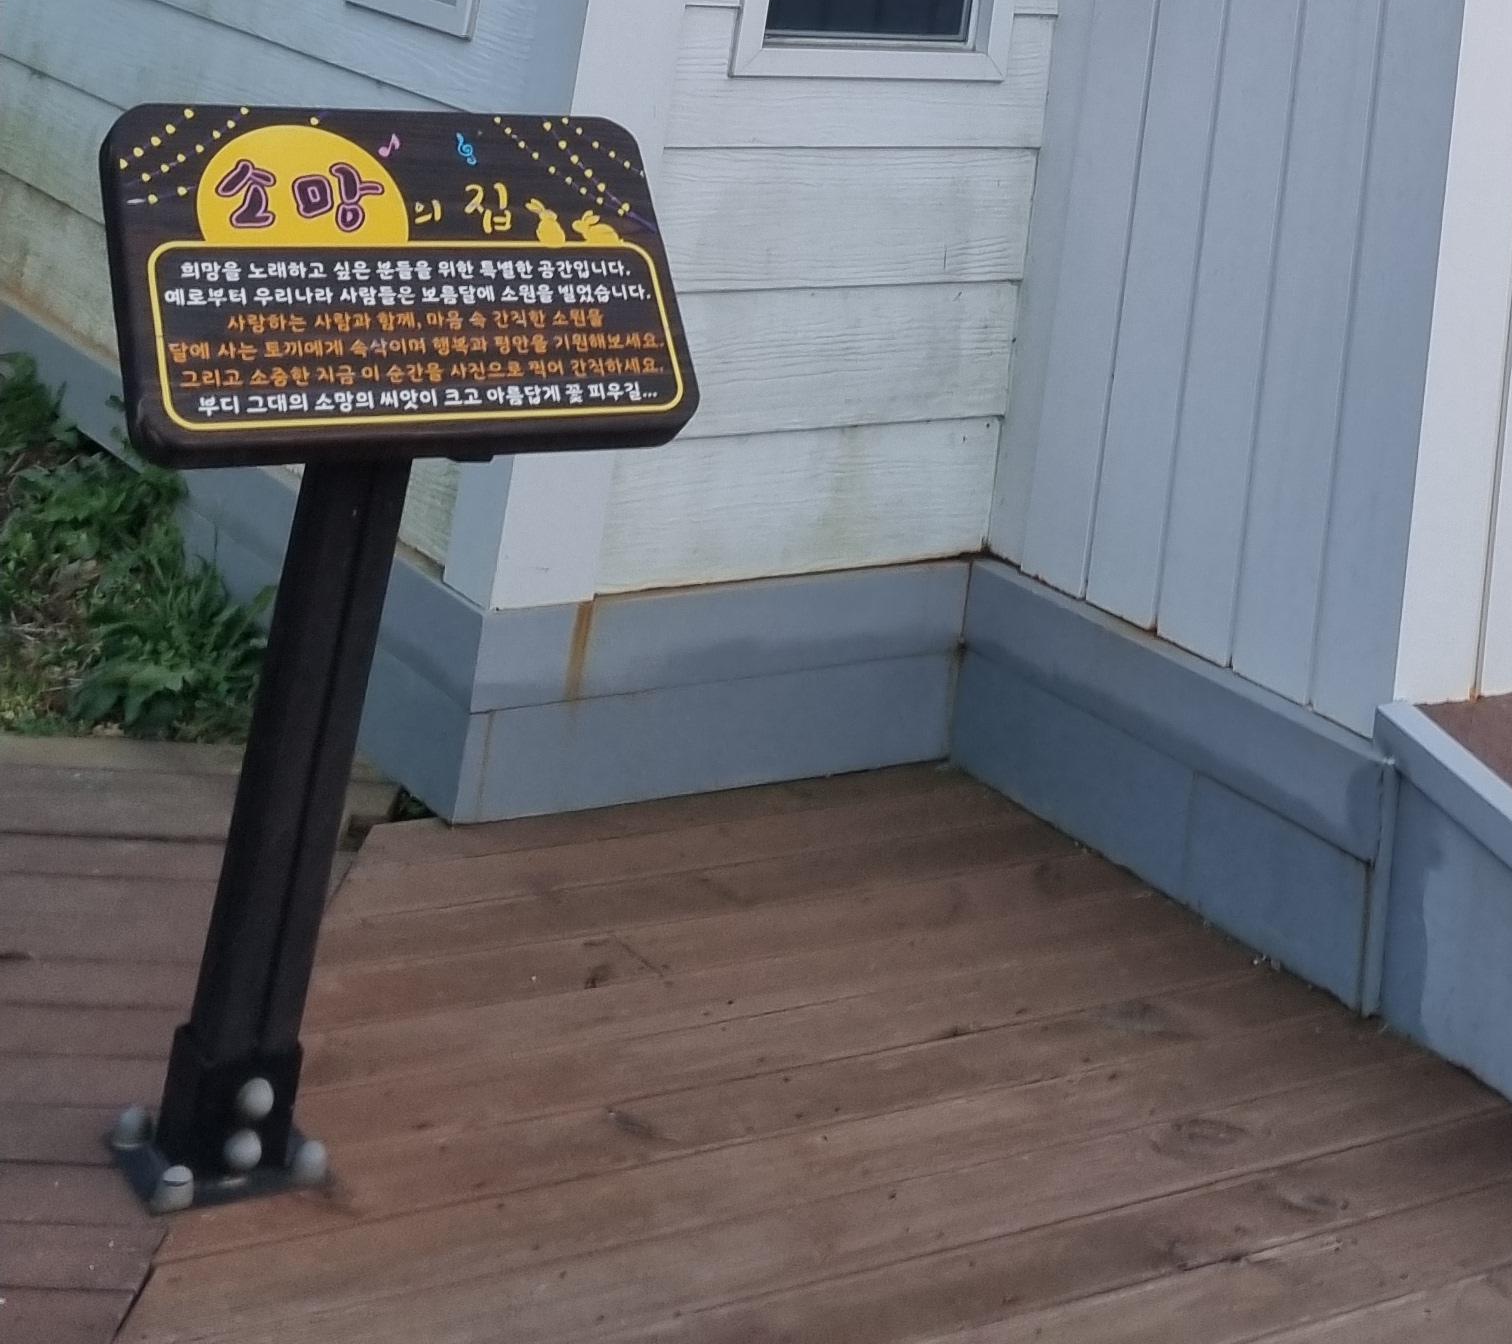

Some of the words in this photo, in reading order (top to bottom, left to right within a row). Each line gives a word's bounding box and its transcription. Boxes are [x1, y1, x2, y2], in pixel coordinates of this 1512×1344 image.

[464, 183, 512, 233] 집
[181, 261, 241, 281] 희망을
[248, 261, 327, 278] 노래하고
[333, 261, 370, 280] 싶은
[376, 260, 432, 280] 분들을
[438, 261, 474, 279] 위한
[480, 261, 533, 279] 특별한
[538, 261, 630, 277] 공간입니다.
[164, 287, 246, 306] 예로부터
[253, 287, 333, 306] 우리나라
[340, 286, 415, 305] 사람들은
[422, 285, 495, 304] 보름달에
[501, 284, 553, 303] 소원을
[558, 284, 651, 303] 빌었습니다.
[228, 313, 307, 334] 사랑하는
[314, 313, 371, 332] 사람과
[377, 311, 422, 331] 함께,
[427, 311, 463, 330] 마음
[469, 311, 486, 328] 속
[494, 309, 546, 328] 간직한
[552, 308, 604, 327] 소원을
[169, 342, 209, 363] 달에
[218, 341, 258, 360] 사는
[264, 340, 343, 358] 토끼에게
[350, 337, 426, 358] 속삭이며
[433, 337, 487, 355] 행복과
[494, 334, 547, 353] 평안을
[180, 369, 243, 388] 그리고
[251, 366, 309, 387] 소중한
[316, 365, 355, 385] 지금
[361, 364, 379, 381] 이
[386, 362, 444, 384] 순간을
[451, 360, 524, 381] 사진으로
[529, 360, 564, 378] 찍어
[570, 357, 664, 377] 간직하세요.
[199, 396, 240, 416] 부디
[247, 393, 308, 412] 그대의
[315, 391, 374, 411] 소망의
[380, 389, 438, 410] 씨앗이
[444, 388, 482, 405] 크고
[486, 385, 561, 406] 아름답게
[566, 384, 583, 404] 꽃
[588, 381, 657, 401] 피우길...
